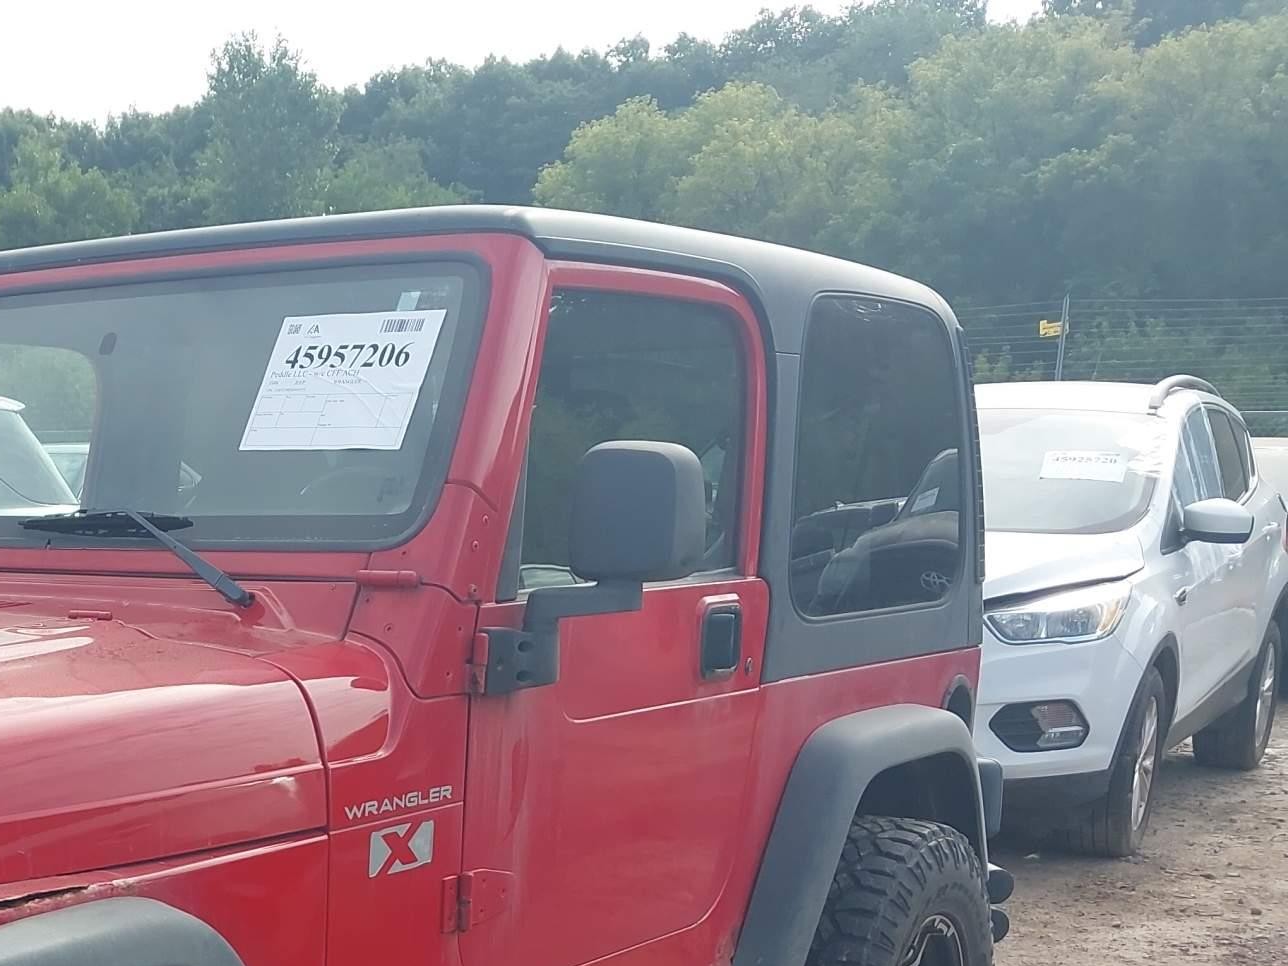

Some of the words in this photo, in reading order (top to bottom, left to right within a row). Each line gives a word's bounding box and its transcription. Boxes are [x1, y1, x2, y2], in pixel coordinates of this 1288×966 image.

[285, 342, 415, 369] 45957206
[344, 785, 453, 821] WRANGLER
[372, 820, 432, 878] X
